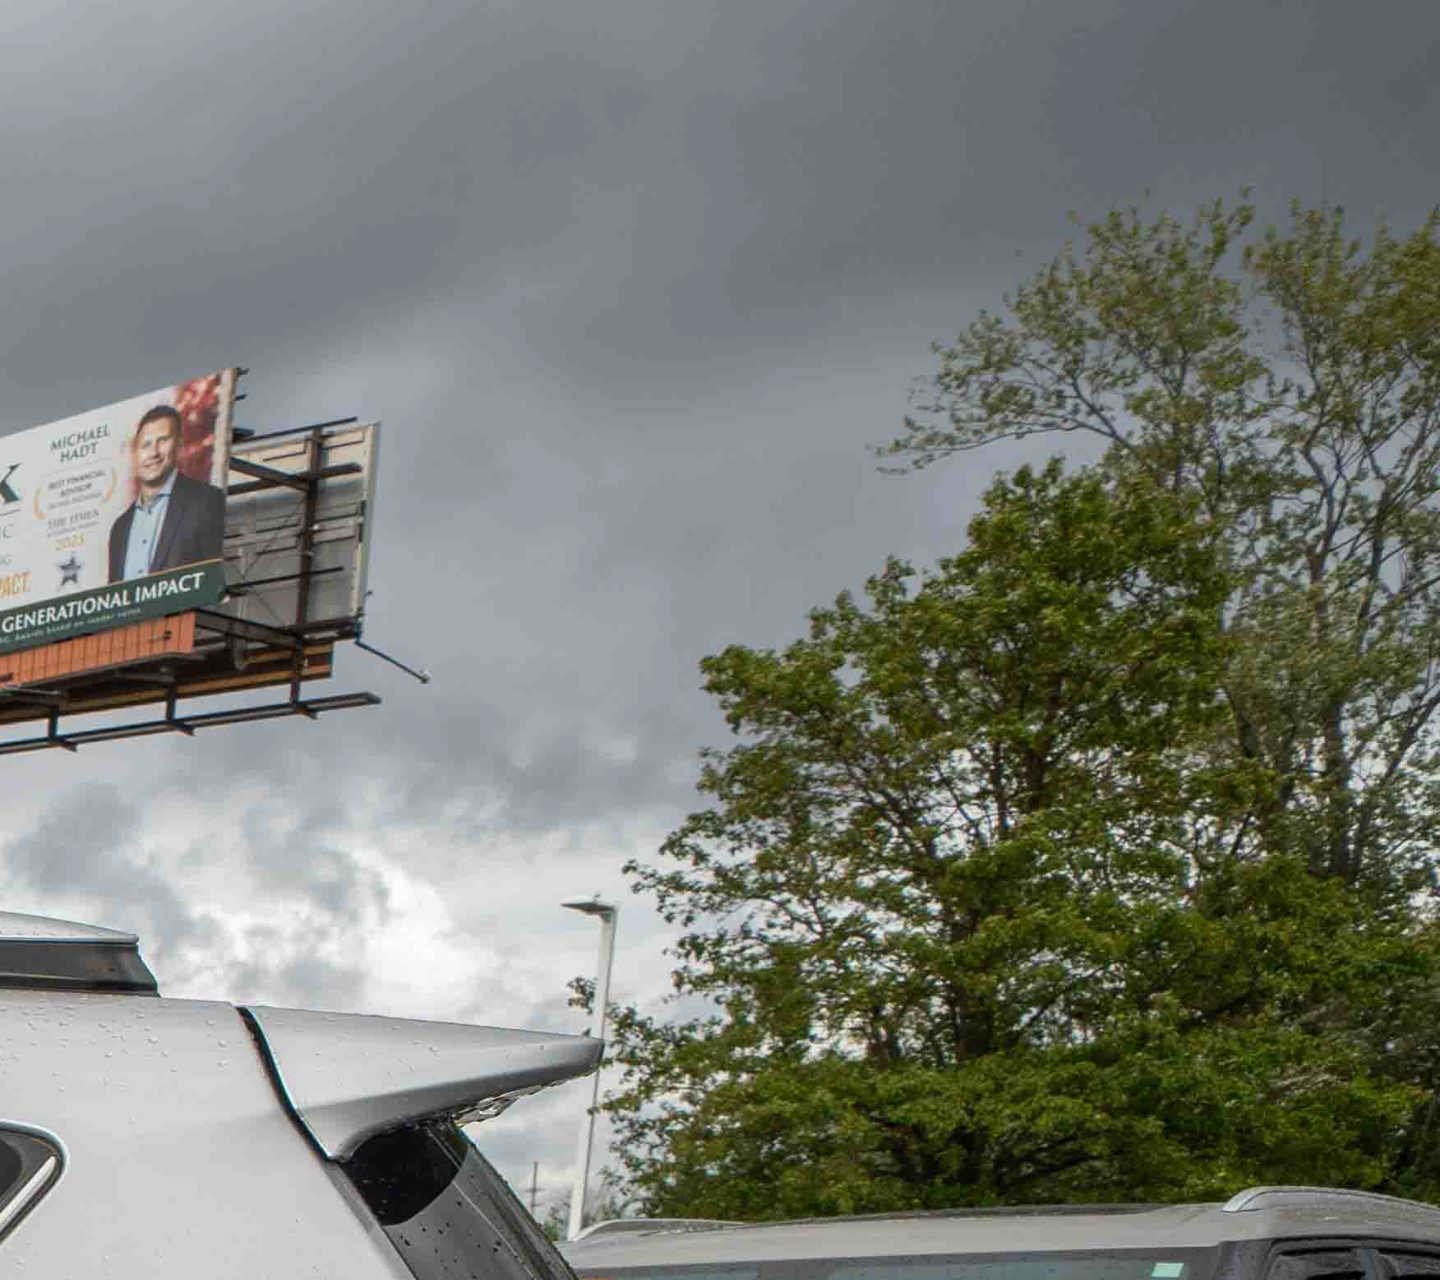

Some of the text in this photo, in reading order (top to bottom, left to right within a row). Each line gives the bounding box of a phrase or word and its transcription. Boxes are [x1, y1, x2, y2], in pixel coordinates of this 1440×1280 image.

[50, 424, 110, 450] MICHAEL
[60, 442, 98, 462] HADT
[1, 590, 131, 634] GENERATIONAL
[135, 572, 205, 603] IMPACT
